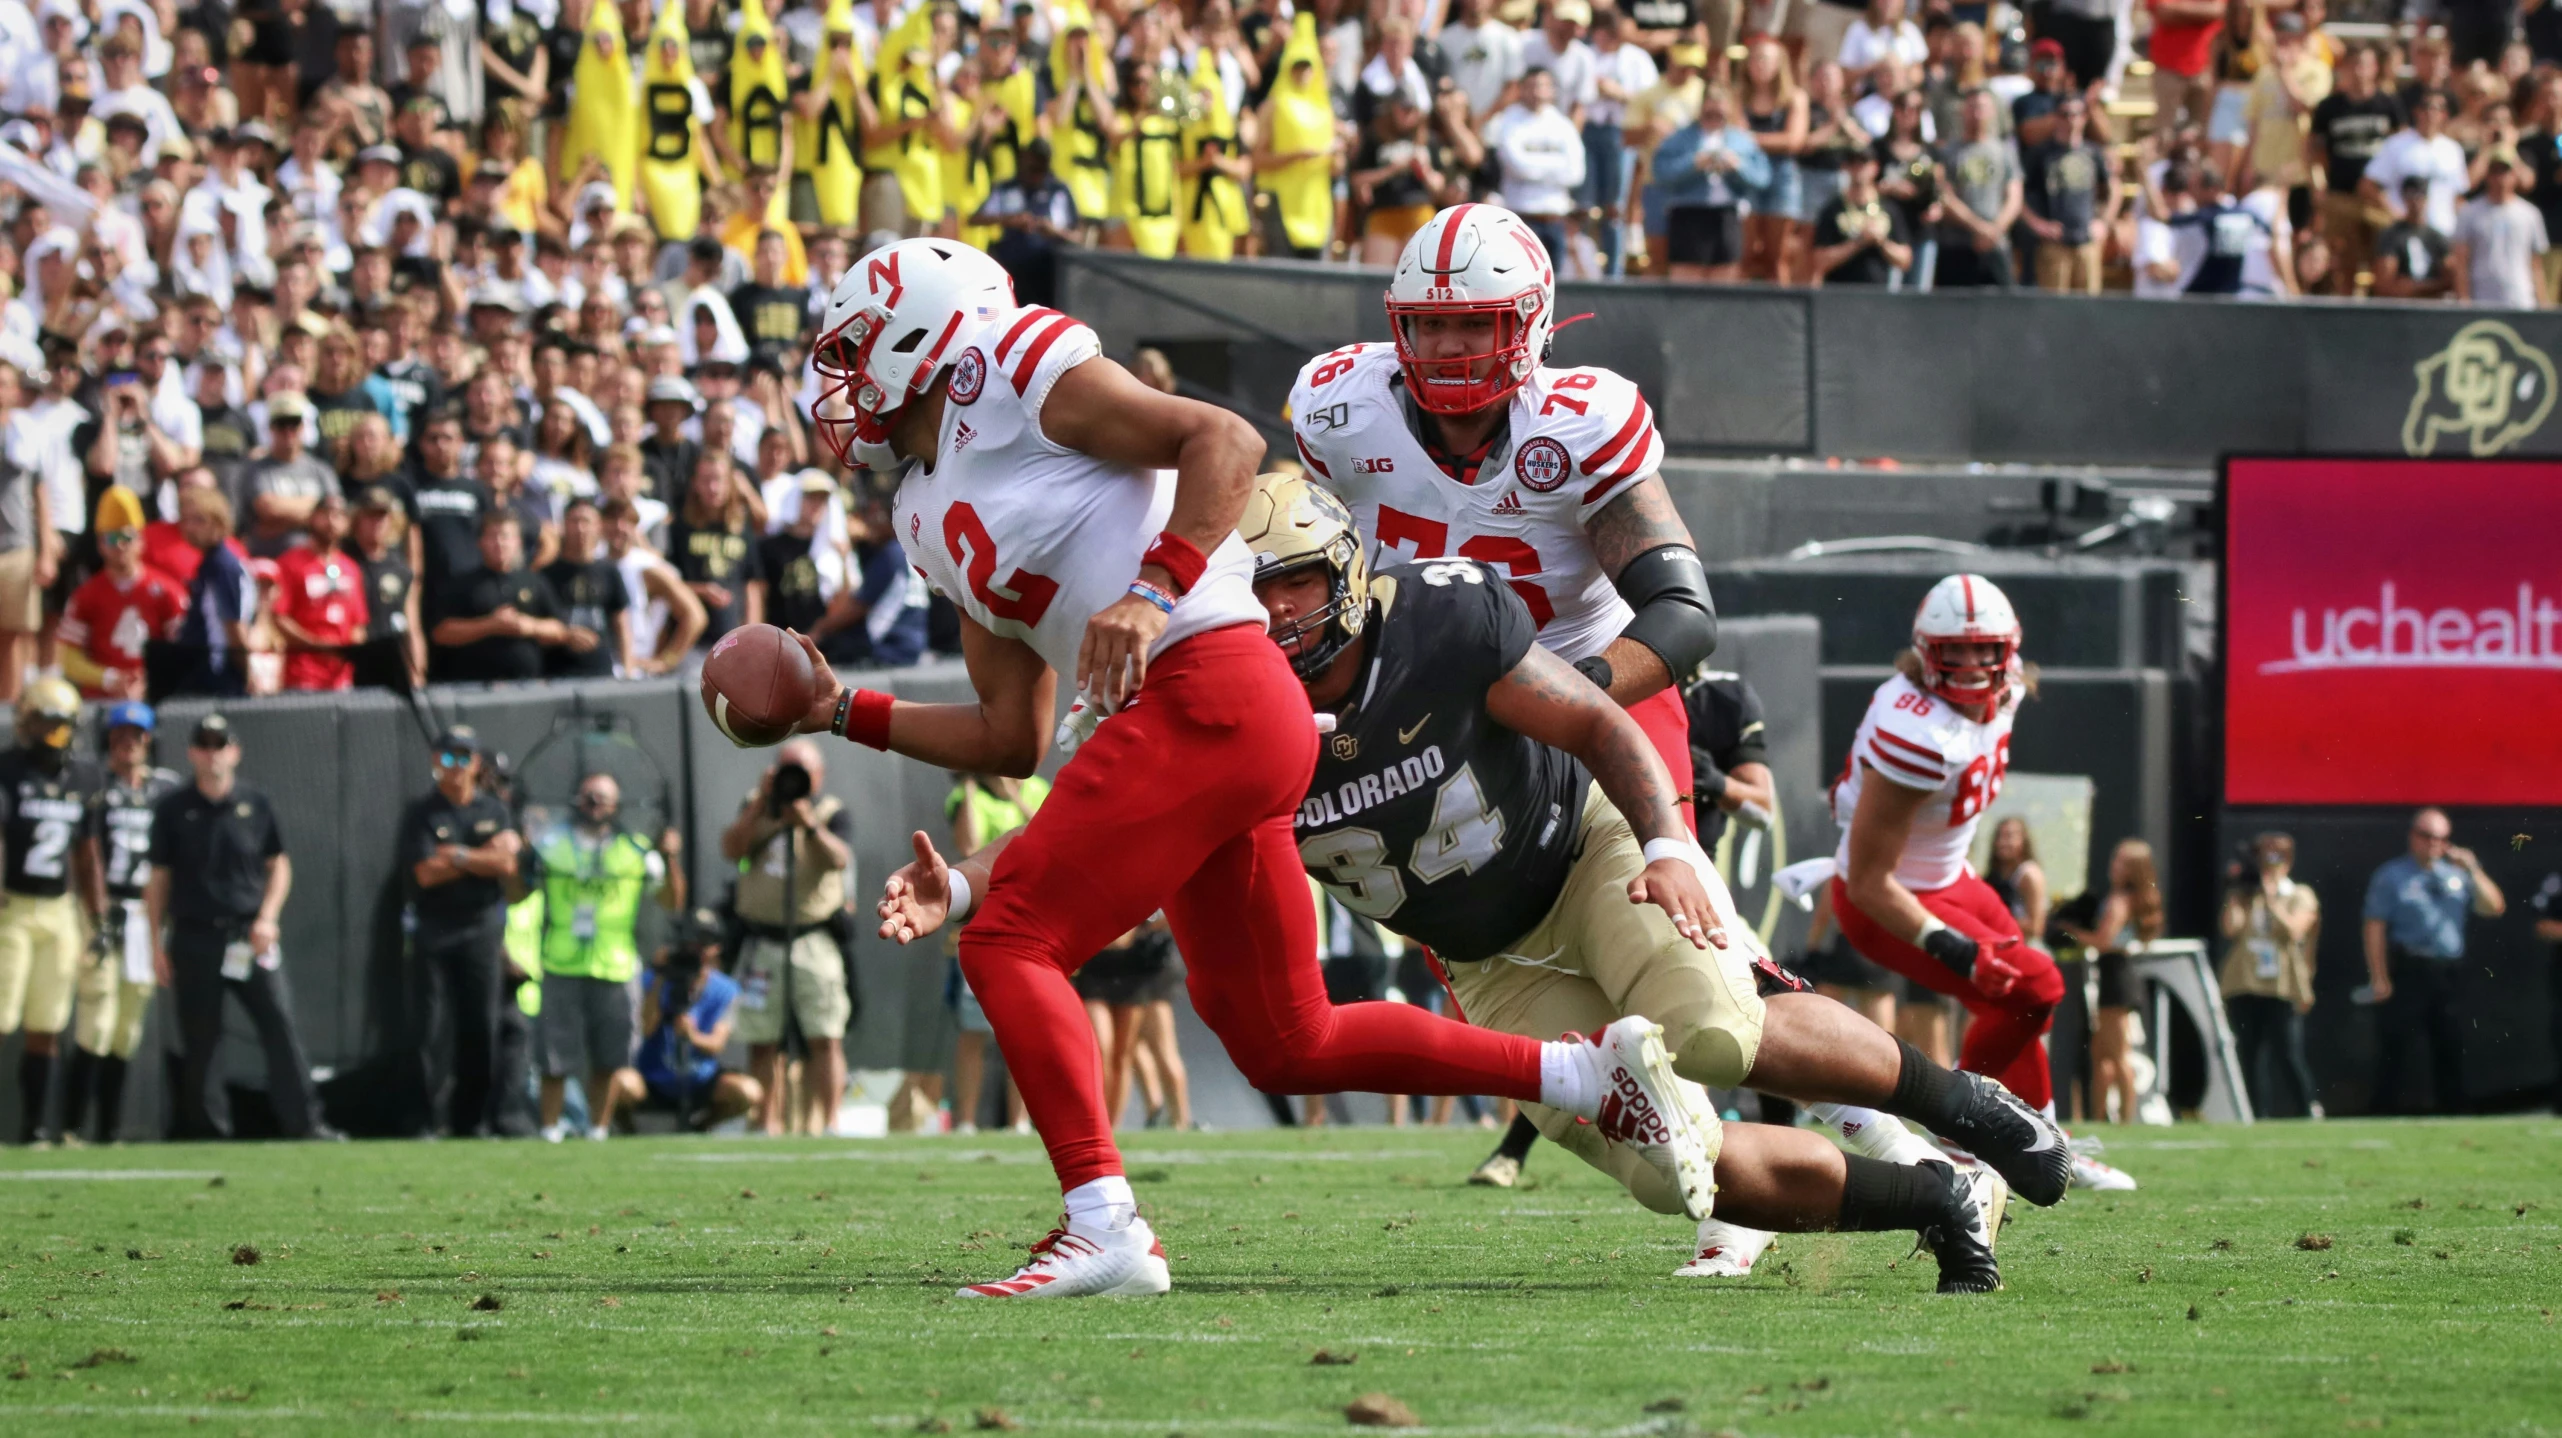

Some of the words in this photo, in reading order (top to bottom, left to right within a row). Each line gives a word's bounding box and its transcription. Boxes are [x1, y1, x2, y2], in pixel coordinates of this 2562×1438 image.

[648, 84, 692, 160] B
[743, 85, 789, 164] A
[1427, 288, 1453, 300] 512
[1539, 374, 1598, 416] 76
[2444, 338, 2517, 426] CU
[1306, 402, 1348, 434] 150
[955, 429, 978, 453] adidas
[1520, 439, 1545, 459] NEBRASKA
[1546, 440, 1568, 464] FOOTBALL
[1527, 460, 1559, 470] HUSKERS
[1492, 506, 1528, 516] adidas
[943, 500, 1060, 629] 2
[1408, 556, 1484, 587] 3
[1331, 734, 1358, 761] CU
[23, 819, 71, 879] 2
[1300, 760, 1507, 920] 34
[1611, 1066, 1671, 1145] adidas
